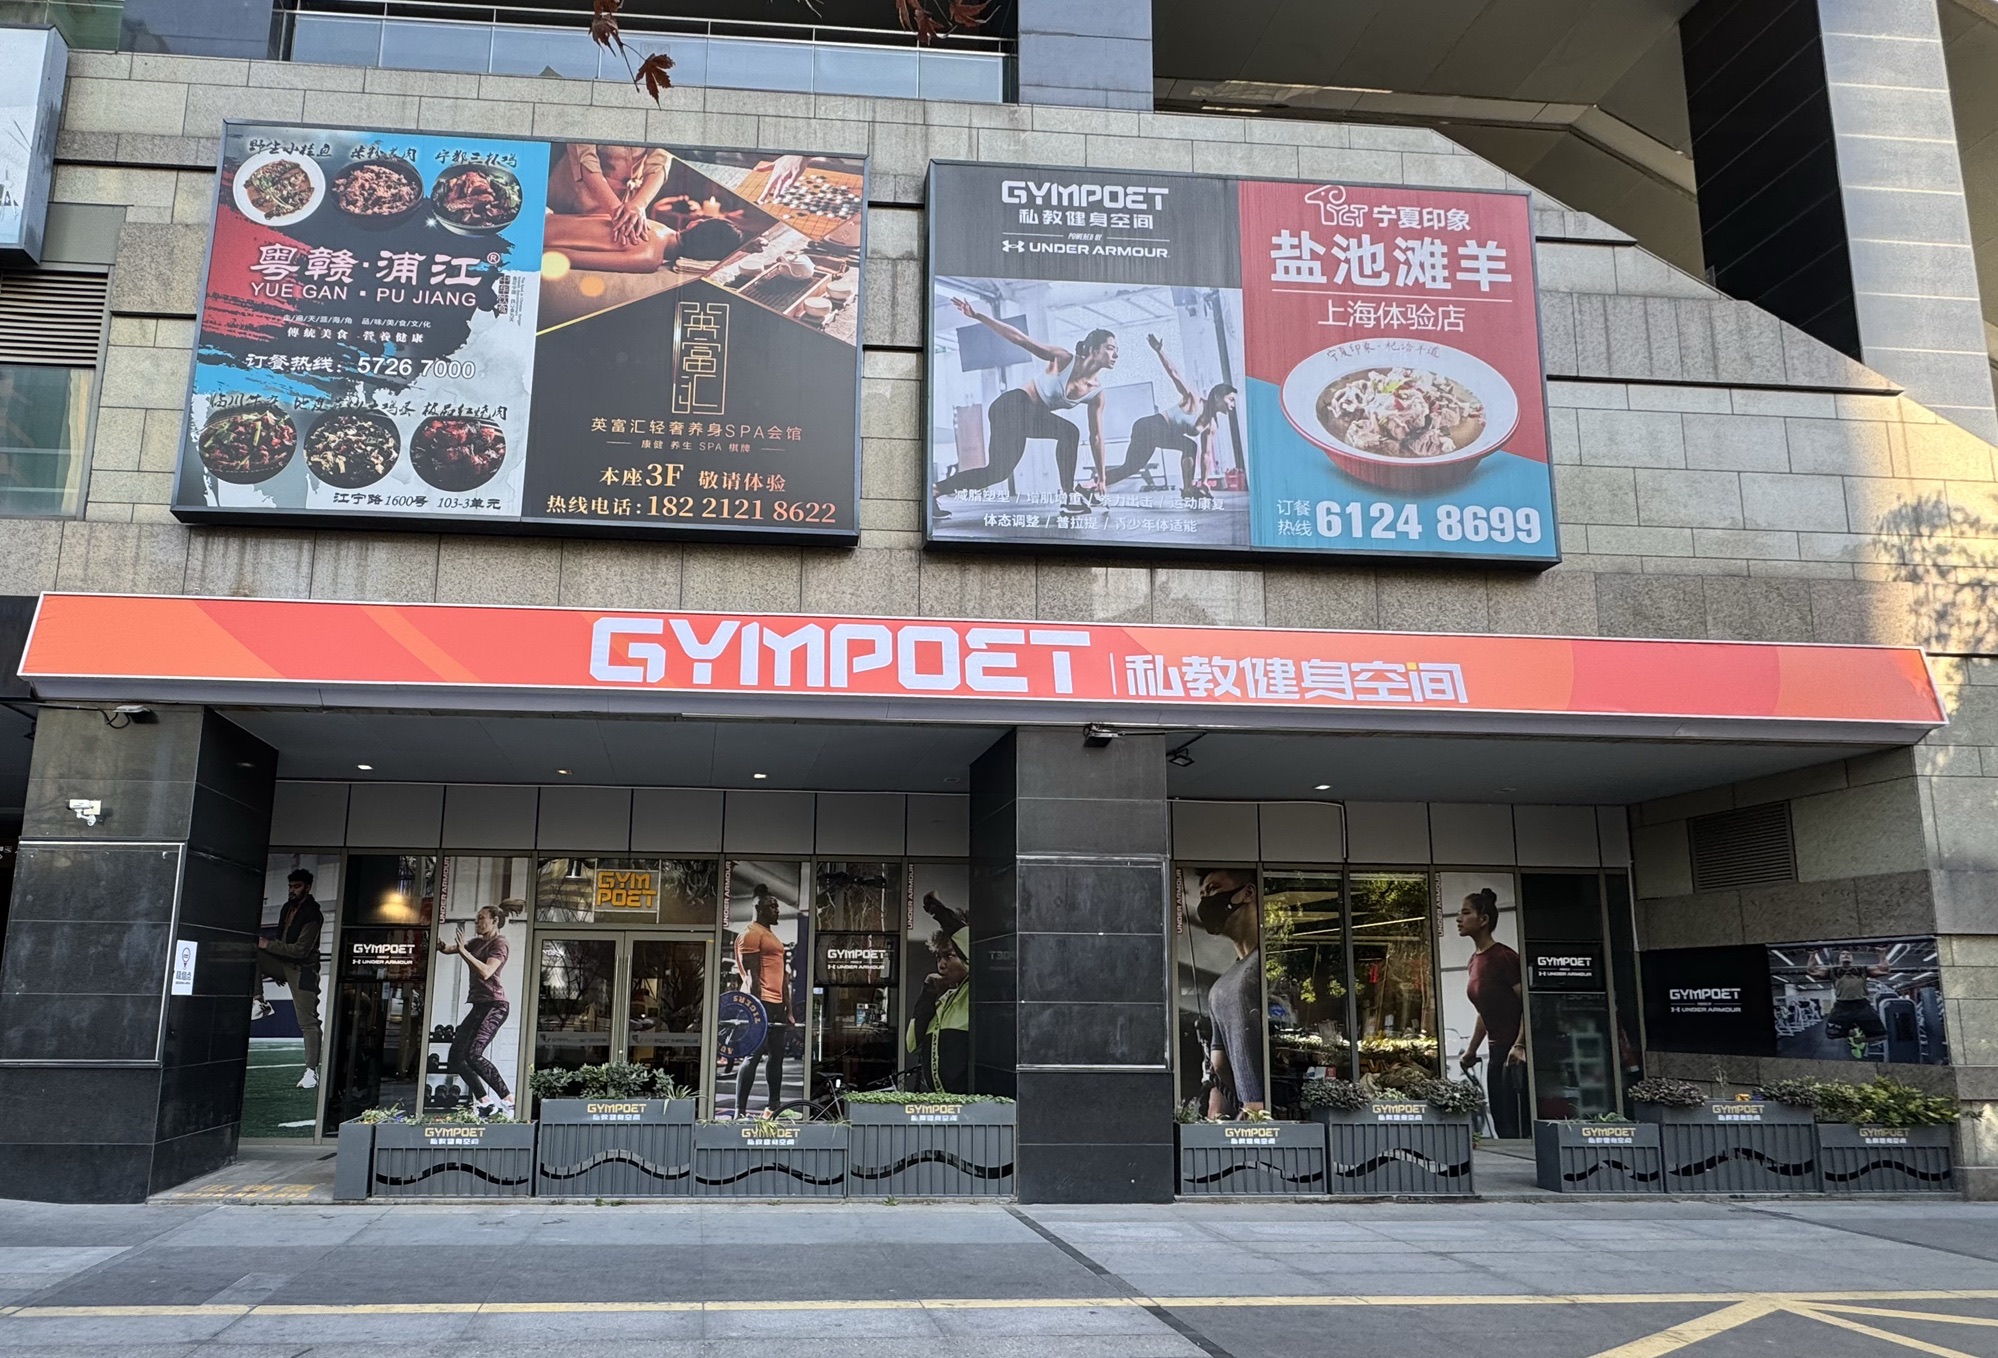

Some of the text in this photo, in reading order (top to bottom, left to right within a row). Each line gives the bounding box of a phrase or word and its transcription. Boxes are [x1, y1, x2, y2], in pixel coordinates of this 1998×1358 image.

[1001, 180, 1169, 210] GYMPOET
[1019, 208, 1153, 230] 私教健身空间
[1372, 204, 1471, 231] 宁夏印象
[1068, 232, 1103, 241] POWERED BY
[1028, 242, 1168, 258] UNDER ARMOUR
[1270, 229, 1512, 292] 盐池滩羊
[250, 282, 477, 307] YUE GAN PU JIANG
[1317, 299, 1466, 333] 上海体验店
[356, 356, 413, 377] 5726
[420, 358, 476, 379] 7000
[590, 417, 802, 441] 英富汇轻奢养身SPA会馆
[670, 440, 692, 450] 养生
[699, 442, 722, 452] SPA
[728, 443, 751, 453] 棋牌
[599, 462, 786, 493] 本座3F 敬请体验
[333, 492, 502, 510] 江宁路1600号 103-3单元
[646, 495, 694, 518] 182
[701, 498, 765, 520] 2121
[772, 500, 836, 523] 8622
[1277, 499, 1311, 517] 订餐
[983, 513, 1040, 528] 体态调整
[1056, 515, 1098, 529] 普拉提
[1277, 518, 1312, 537] 热线
[1315, 500, 1541, 544] 6124 8699
[589, 616, 1091, 694] GYMPOET
[1124, 654, 1468, 703] 私教健身空间
[597, 871, 651, 889] GYM
[439, 856, 450, 924] UNDER ARMOUR
[596, 888, 657, 907] POET
[353, 943, 416, 954] GYMPOET
[827, 949, 886, 959] GYMPOET
[1537, 956, 1592, 967] GYMPOET
[1669, 988, 1742, 1000] GYMPOET
[733, 995, 761, 1024] TIGERS
[587, 1103, 647, 1114] GYMPOET
[905, 1104, 963, 1114] GYMPOET
[1372, 1104, 1427, 1114] GYMPOET
[1712, 1104, 1765, 1114] GYMPOET
[424, 1127, 486, 1138] GYMPOET
[1224, 1127, 1281, 1138] GYMPOET
[1582, 1128, 1637, 1137] GYMPOET
[1859, 1127, 1911, 1137] GYMPOET
